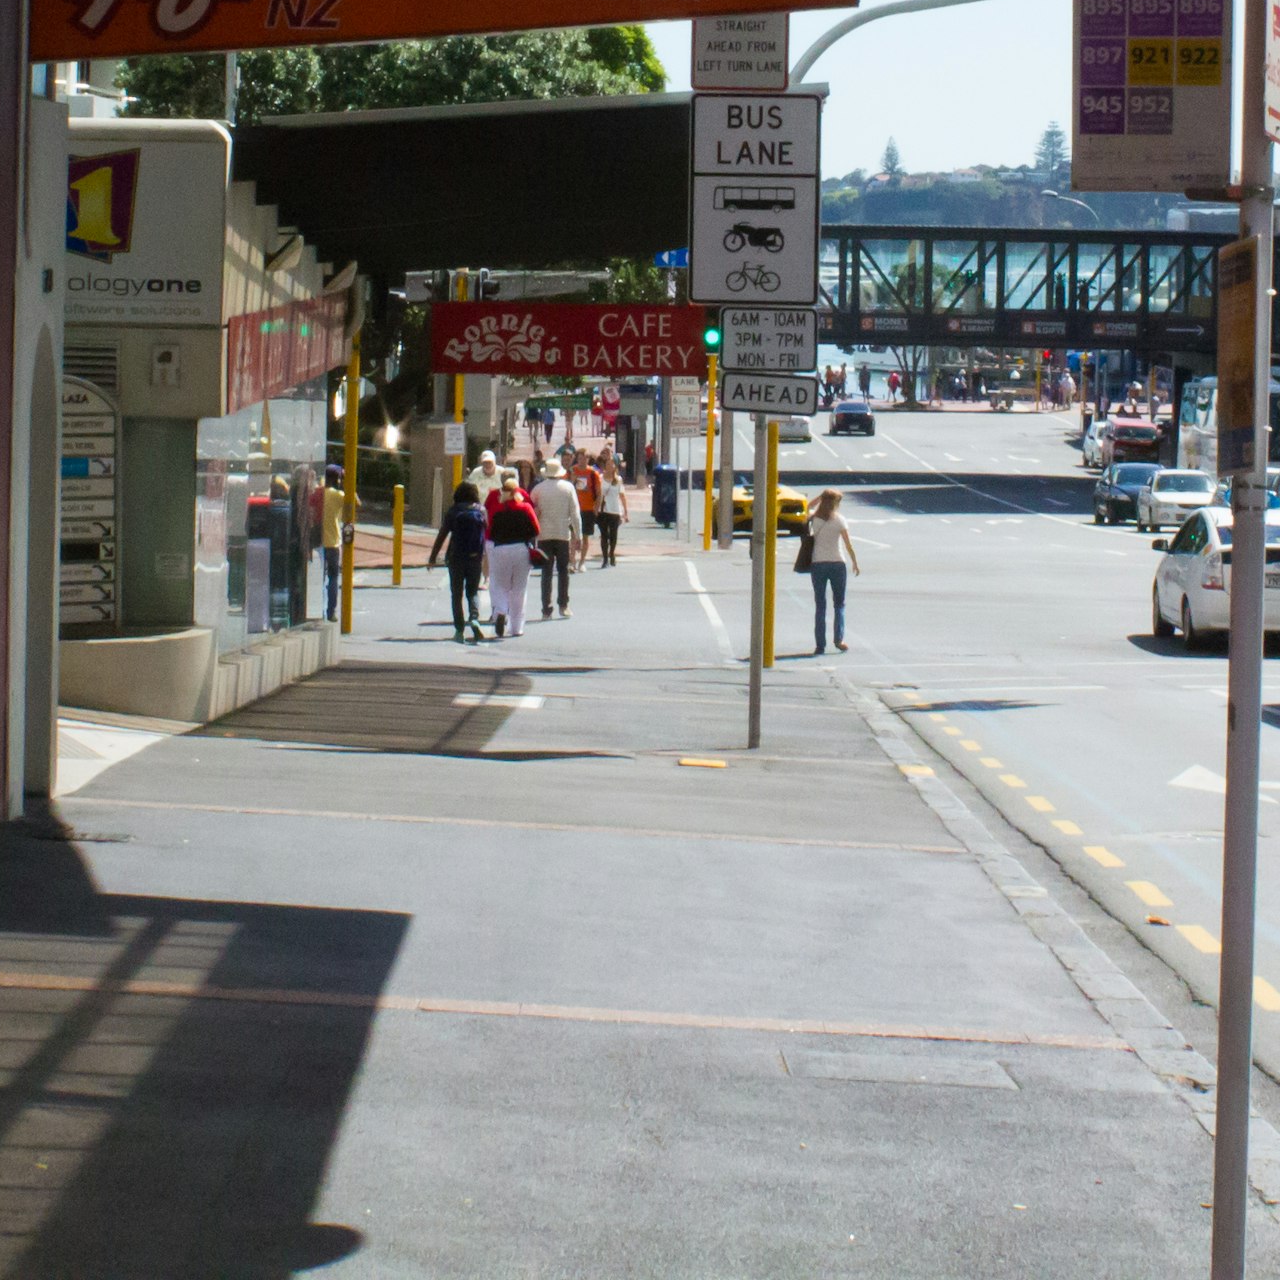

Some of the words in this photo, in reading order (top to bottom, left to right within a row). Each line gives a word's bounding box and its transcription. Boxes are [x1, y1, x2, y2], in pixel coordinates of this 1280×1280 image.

[716, 20, 767, 32] STRAIGHT
[707, 41, 743, 53] AHEAD
[747, 41, 776, 53] FROM
[1082, 46, 1122, 64] 897
[1132, 47, 1169, 64] 921
[1180, 47, 1219, 65] 922
[697, 61, 723, 72] LEFT
[727, 61, 753, 72] TURN
[756, 61, 783, 73] LANE
[1082, 96, 1122, 114] 945
[1130, 96, 1170, 114] 952
[727, 105, 783, 129] BUS
[717, 141, 793, 165] LANE
[68, 273, 202, 295] ologyone
[599, 313, 672, 338] CAFE
[731, 313, 760, 326] 6AM
[774, 313, 806, 327] 10AM
[443, 313, 561, 365] Ronnie's
[735, 333, 762, 346] 3PM
[775, 334, 804, 347] 7PM
[573, 345, 695, 369] BAKERY
[737, 353, 766, 367] MON
[779, 354, 800, 368] FRI
[63, 393, 89, 404] LAZA
[732, 383, 808, 405] AHEAD
